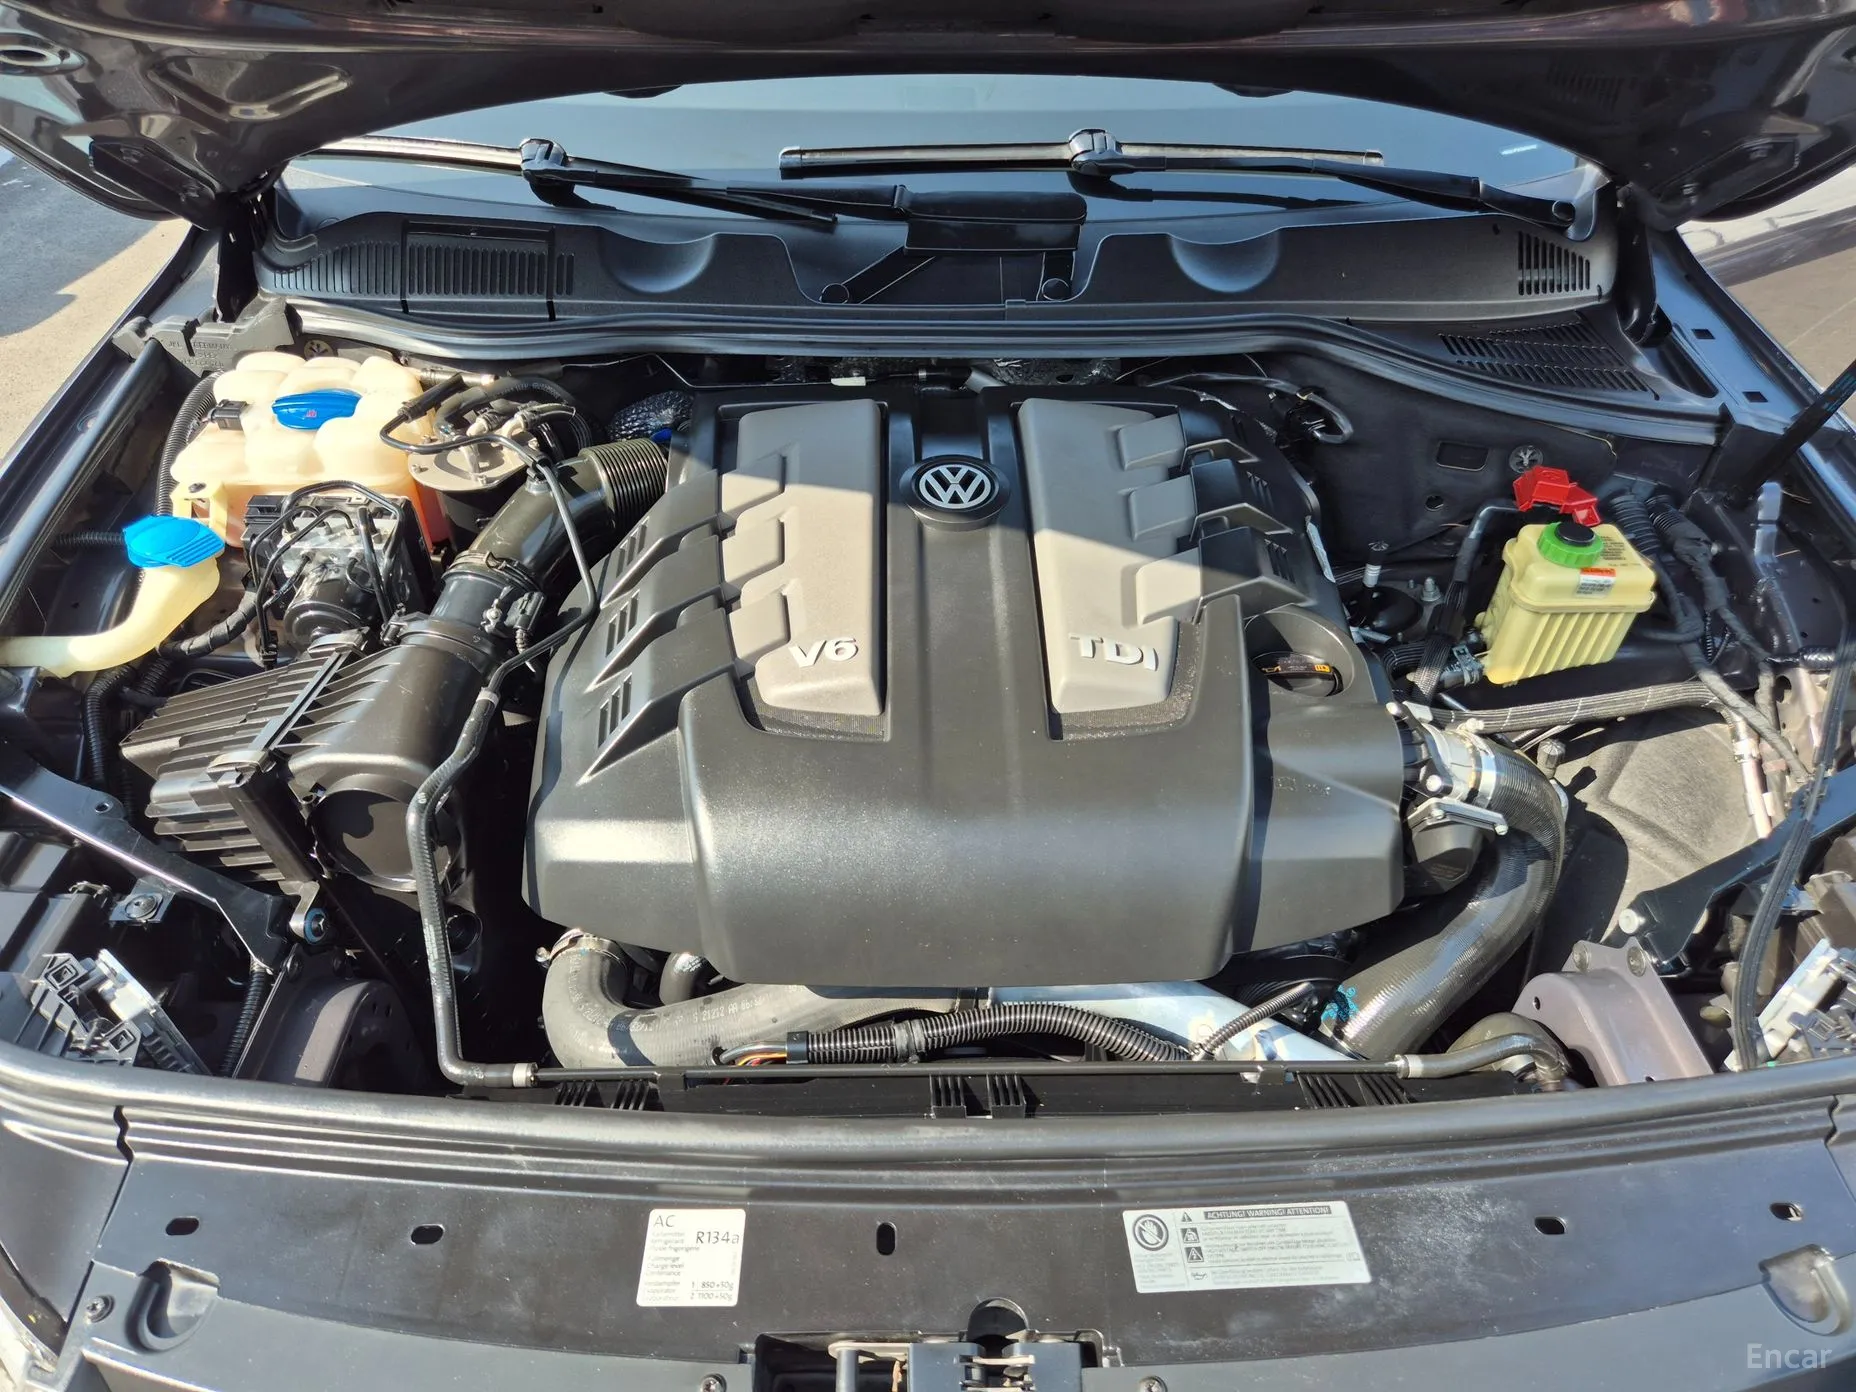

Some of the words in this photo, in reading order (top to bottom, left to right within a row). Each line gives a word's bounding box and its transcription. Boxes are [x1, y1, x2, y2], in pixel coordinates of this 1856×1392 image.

[919, 464, 991, 509] VW
[788, 637, 858, 668] V6
[1069, 632, 1159, 671] TDI
[653, 1214, 676, 1227] AC
[1206, 1210, 1246, 1219] ACHTUNG!
[1247, 1208, 1286, 1217] WARNING!
[1287, 1206, 1329, 1216] ATTENTION!
[696, 1231, 739, 1244] R134a
